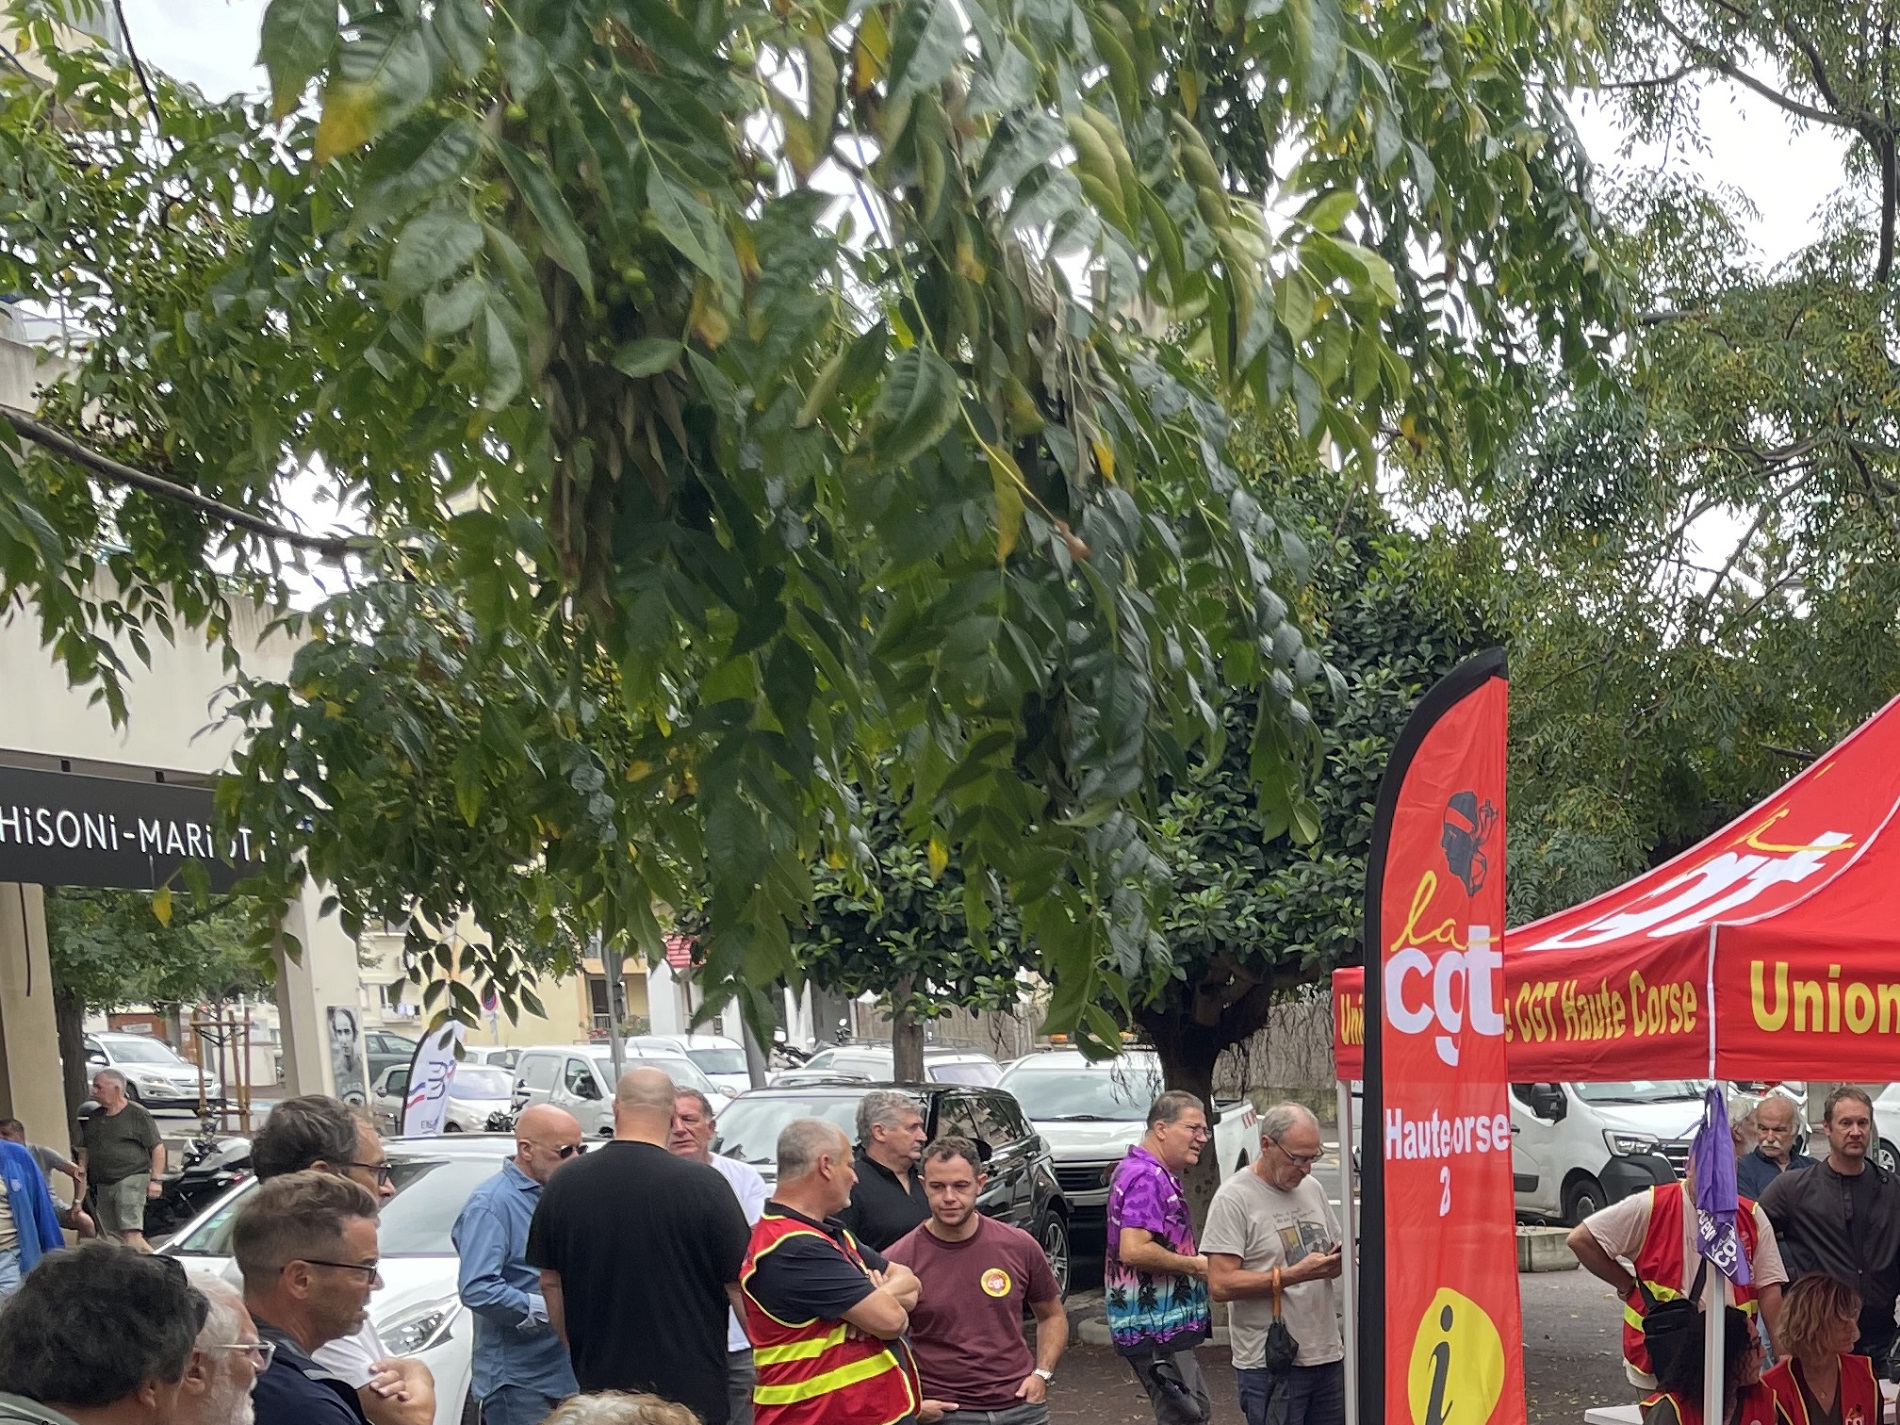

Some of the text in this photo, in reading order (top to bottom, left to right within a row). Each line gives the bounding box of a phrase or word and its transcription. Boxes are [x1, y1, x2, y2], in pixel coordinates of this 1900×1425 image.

[1390, 870, 1499, 952] la
[1514, 981, 1560, 1043] CGT
[1561, 979, 1627, 1042] Haute
[1628, 969, 1698, 1038] Corse
[1386, 1108, 1451, 1160] Haute
